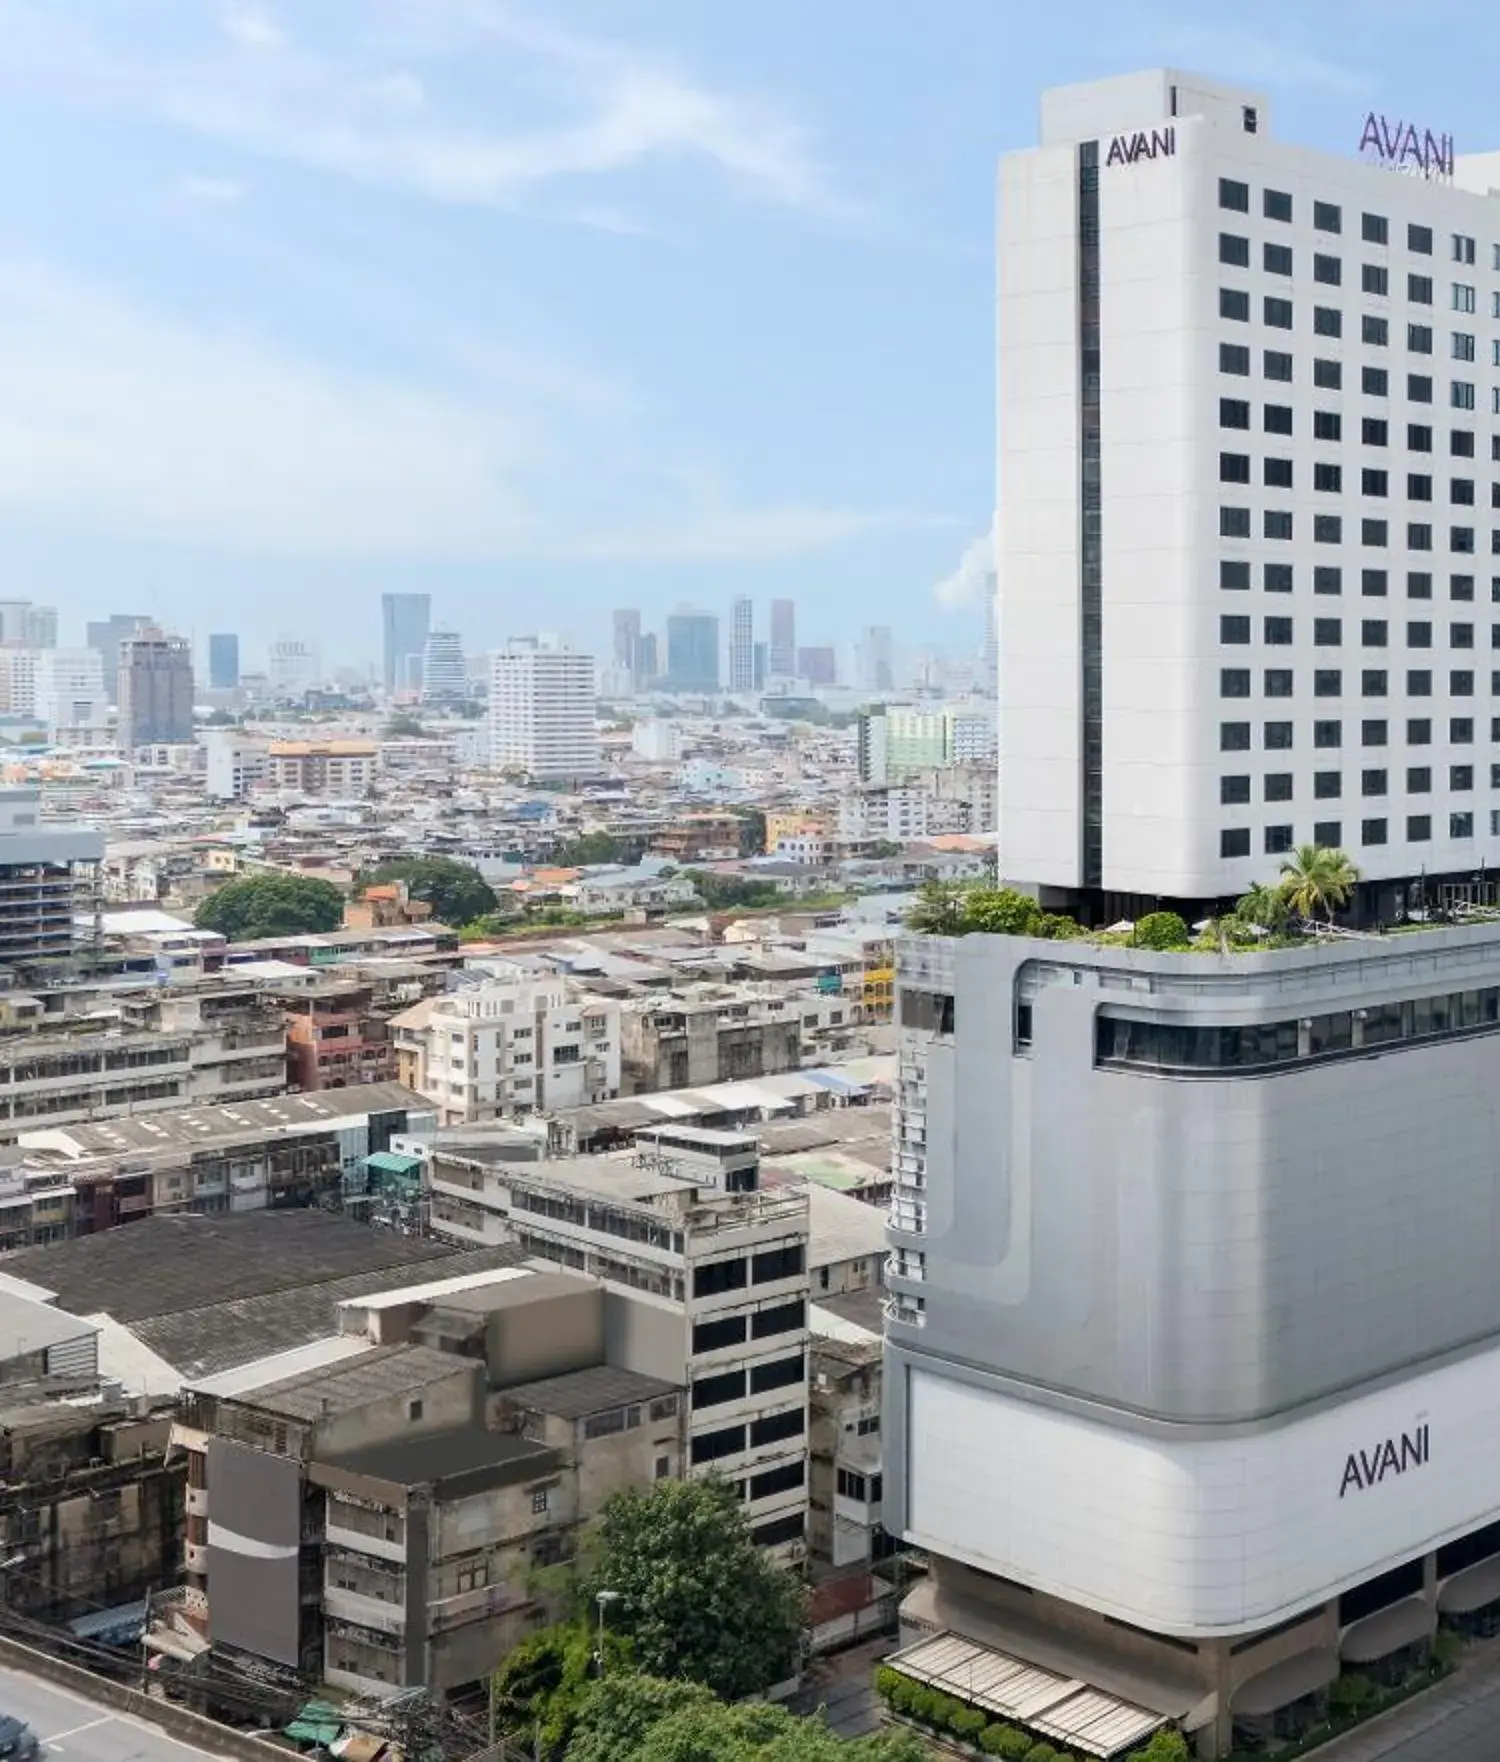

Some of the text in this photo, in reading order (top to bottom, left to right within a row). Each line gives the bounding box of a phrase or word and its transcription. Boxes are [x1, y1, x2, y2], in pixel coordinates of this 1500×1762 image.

[1106, 126, 1175, 167] AVANI
[1359, 111, 1453, 180] AVANI
[1338, 1423, 1429, 1498] AVANI
